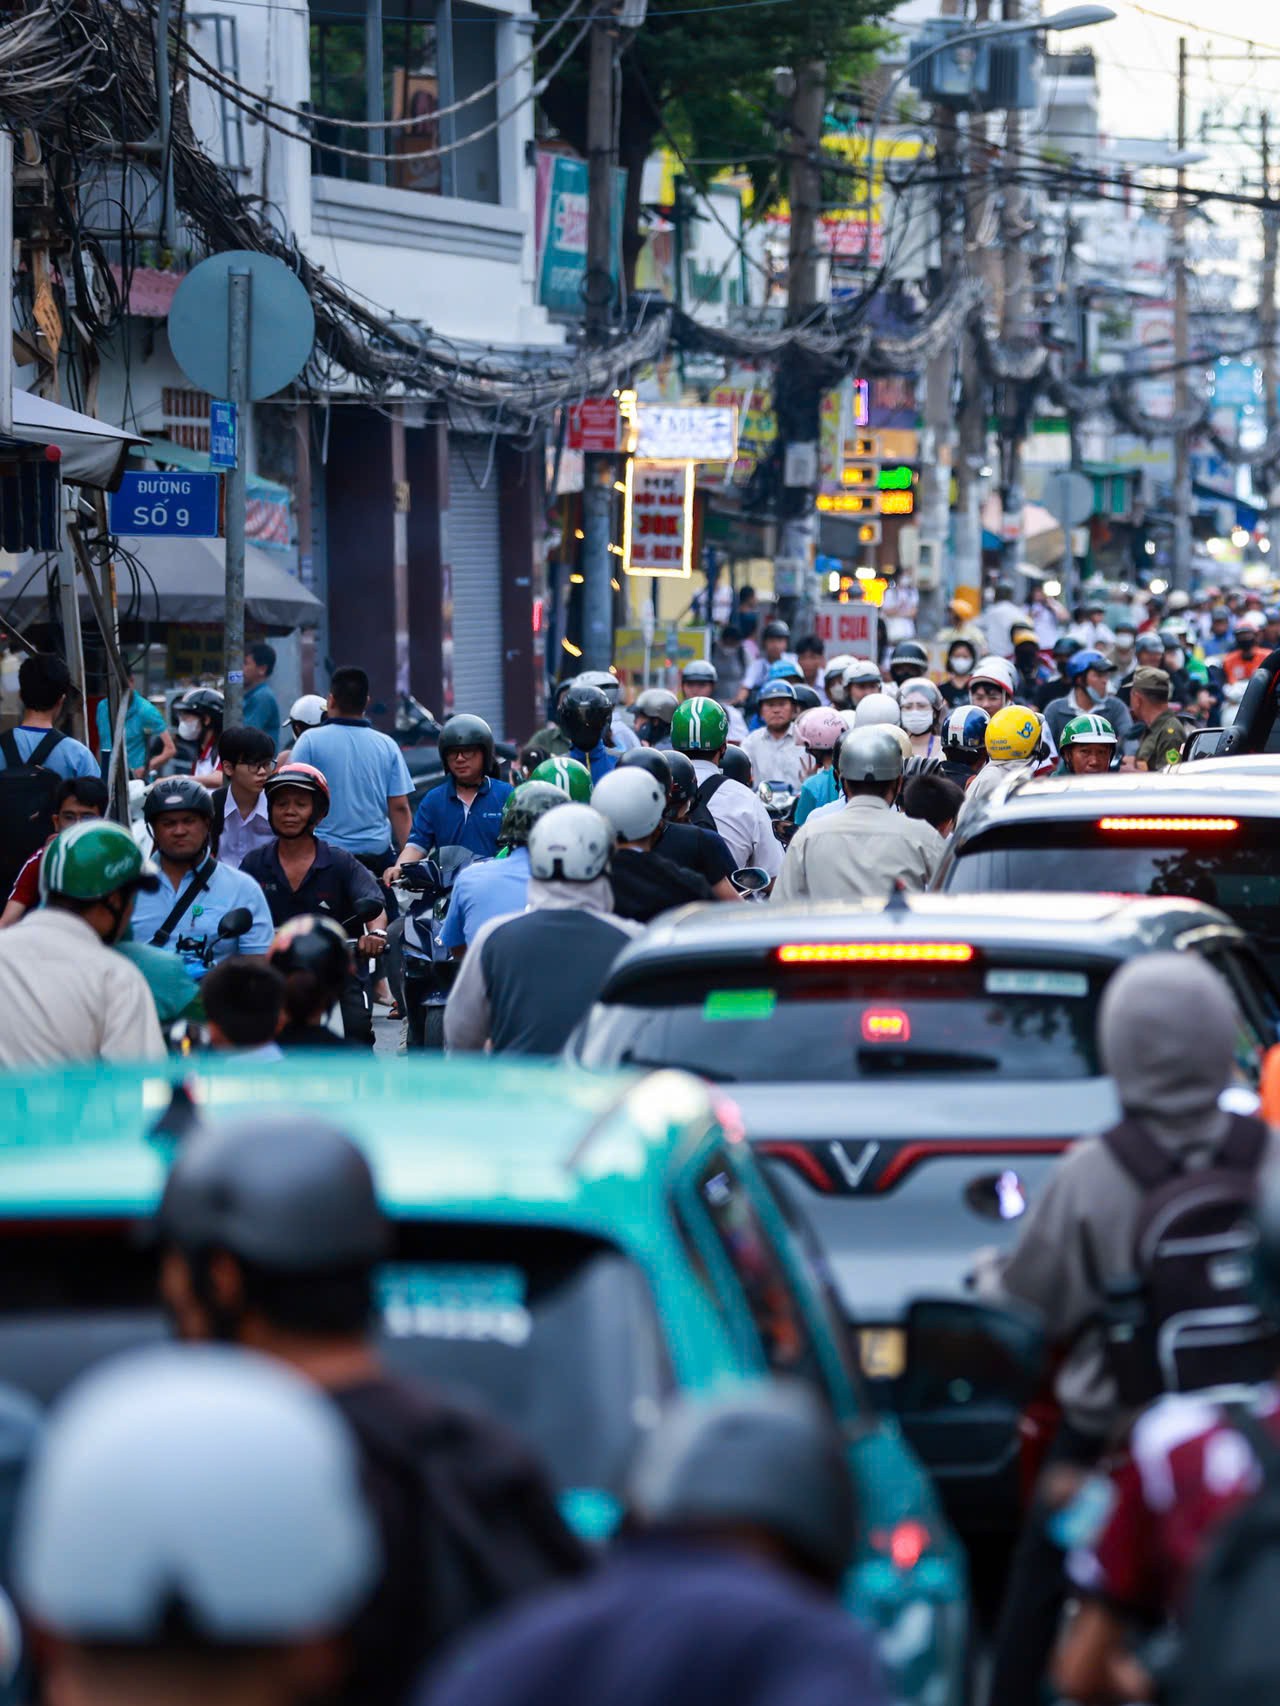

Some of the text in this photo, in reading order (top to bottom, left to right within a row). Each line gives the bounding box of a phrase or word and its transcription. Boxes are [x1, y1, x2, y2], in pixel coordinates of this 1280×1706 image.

[137, 476, 191, 495] ĐƯỜNG
[133, 499, 190, 527] SỐ 9
